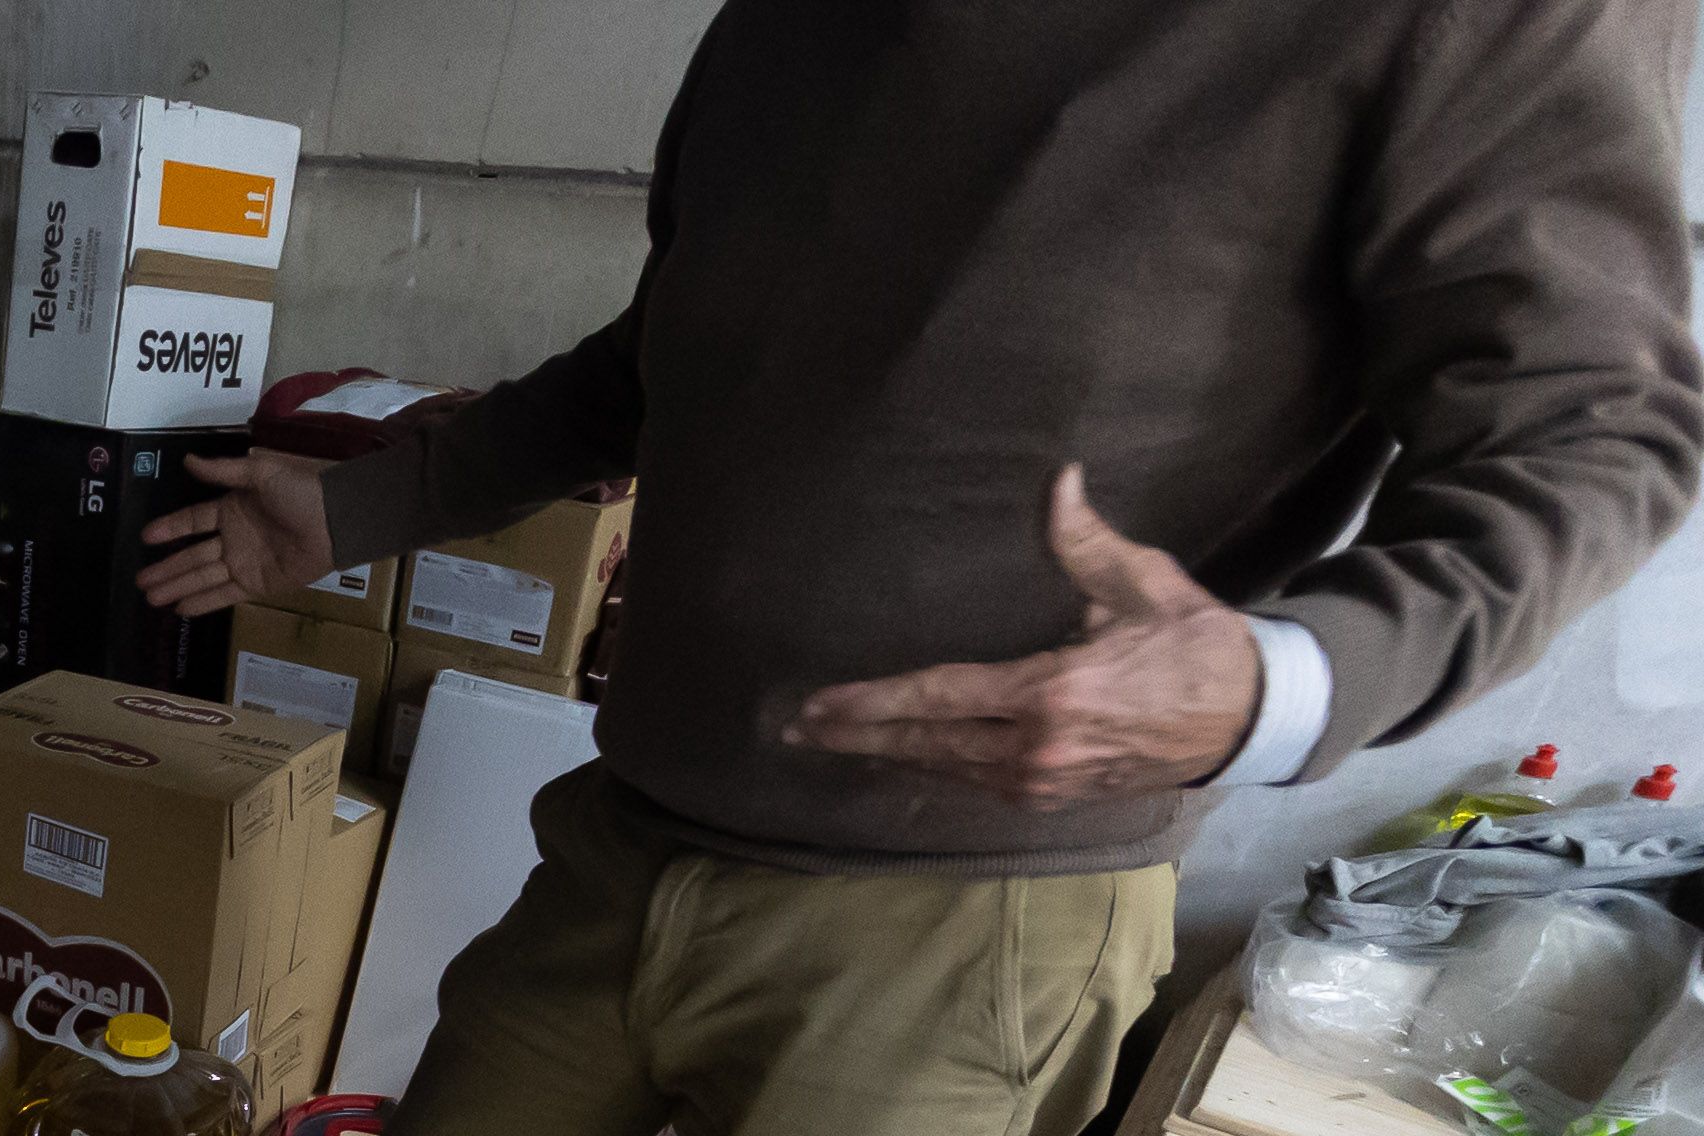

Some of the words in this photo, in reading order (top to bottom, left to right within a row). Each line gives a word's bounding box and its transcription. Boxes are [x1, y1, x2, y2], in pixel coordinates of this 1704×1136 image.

[30, 200, 66, 338] Televes
[136, 329, 243, 388] Televes
[87, 479, 105, 513] LG
[19, 539, 34, 624] MICROWAVE
[16, 629, 29, 666] OVEN
[123, 697, 222, 723] Carbonell
[46, 735, 149, 765] Carbonell
